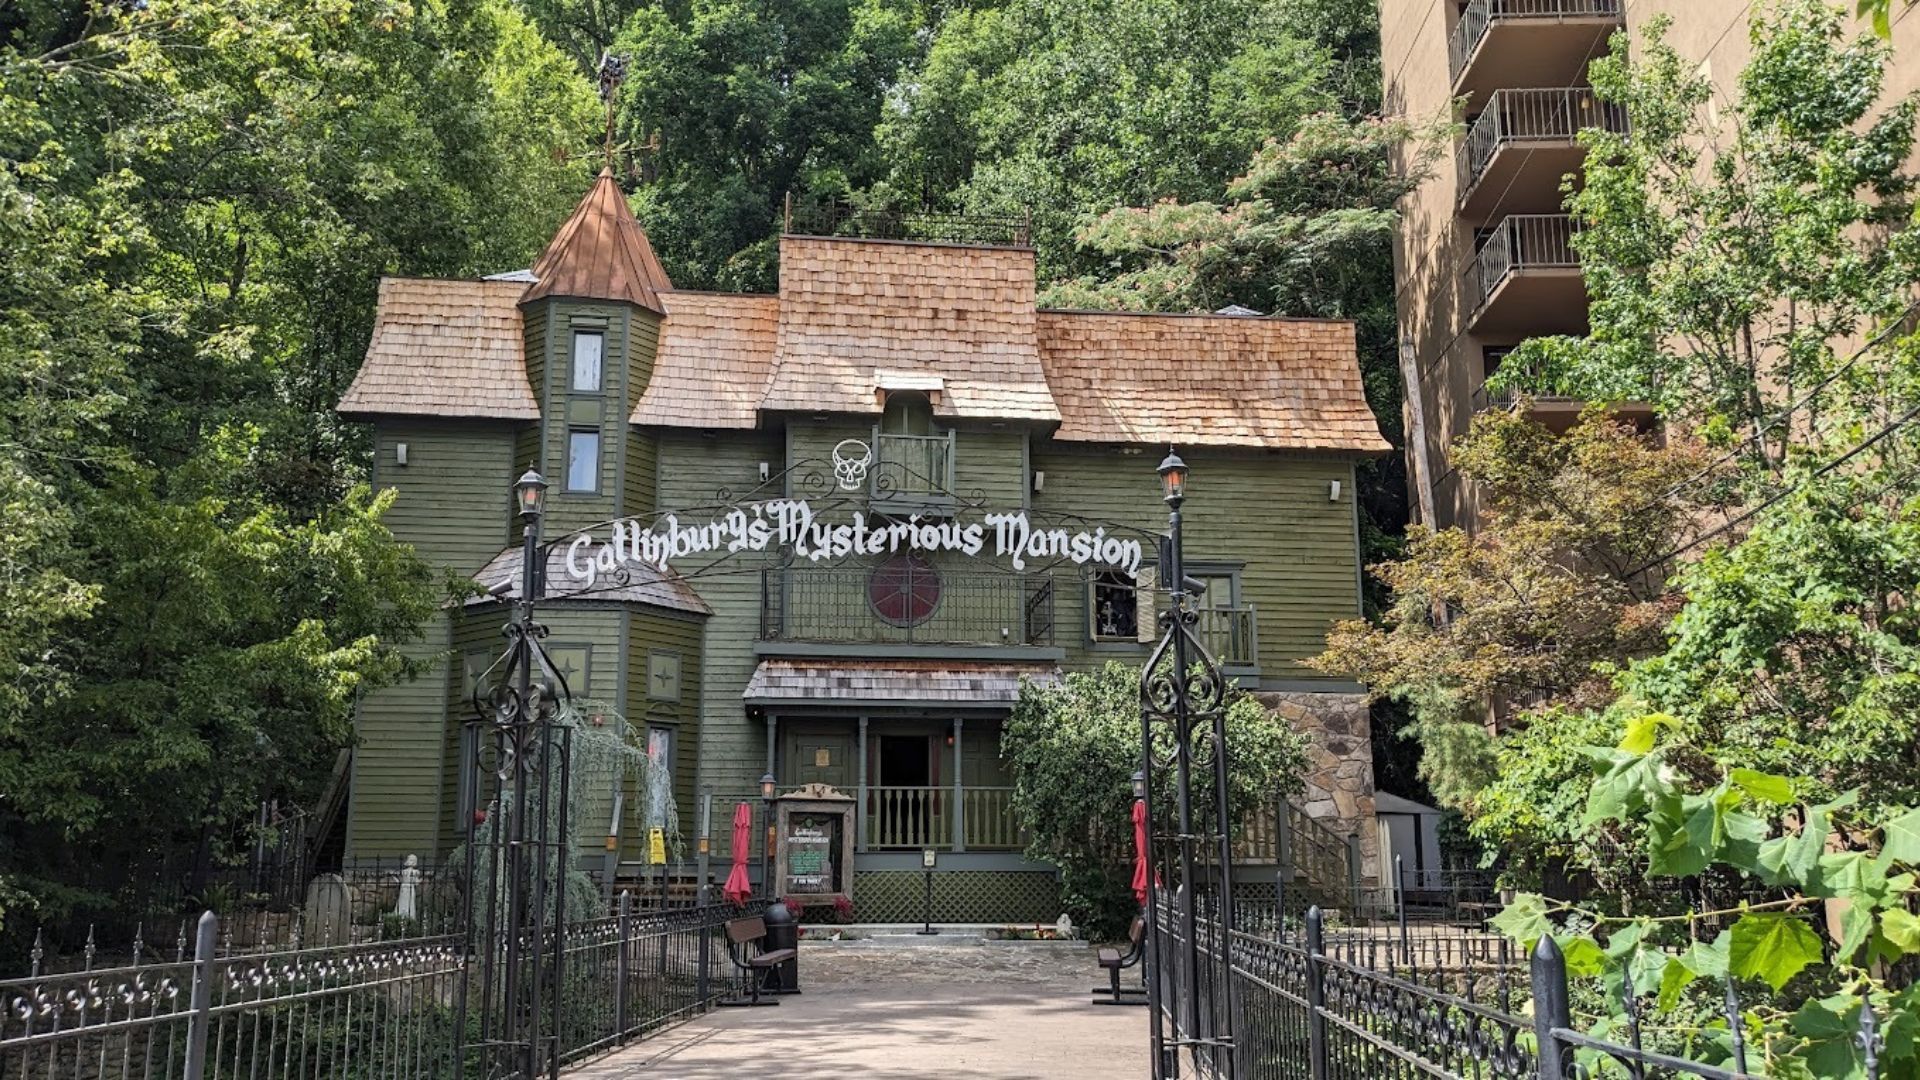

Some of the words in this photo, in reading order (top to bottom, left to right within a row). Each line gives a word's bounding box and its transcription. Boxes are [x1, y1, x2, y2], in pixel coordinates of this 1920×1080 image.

[566, 503, 771, 588] Gatlinburg's
[766, 499, 984, 562] Mysterious
[984, 511, 1142, 579] Mansion
